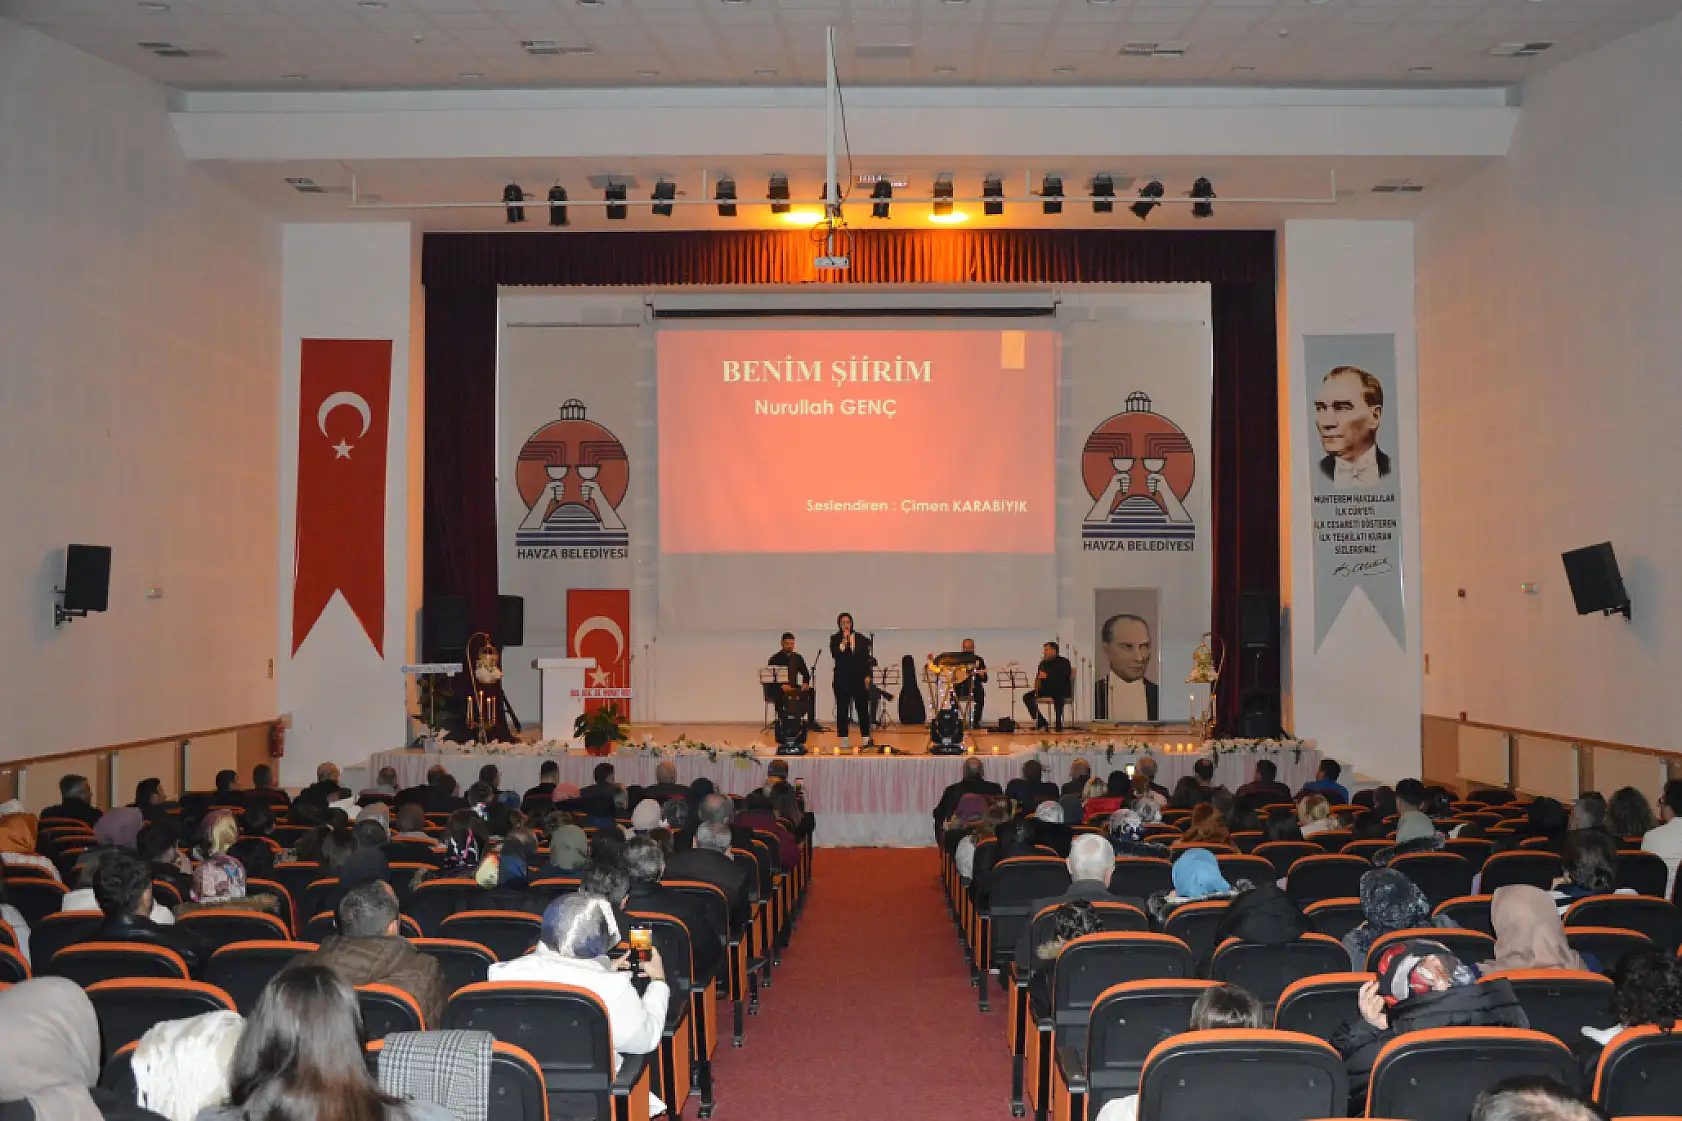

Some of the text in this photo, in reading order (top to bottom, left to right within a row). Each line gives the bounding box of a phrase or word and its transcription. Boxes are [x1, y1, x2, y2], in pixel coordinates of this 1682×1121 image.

[721, 354, 933, 388] BENİM ŞİİRİM
[755, 399, 897, 419] Nurullah GENÇ
[806, 499, 889, 512] Seslendiren
[900, 499, 949, 513] Çimen
[1083, 539, 1194, 552] HAVZA BELEDİYESİ
[517, 547, 629, 560] HAVZA BELEDİYESİ
